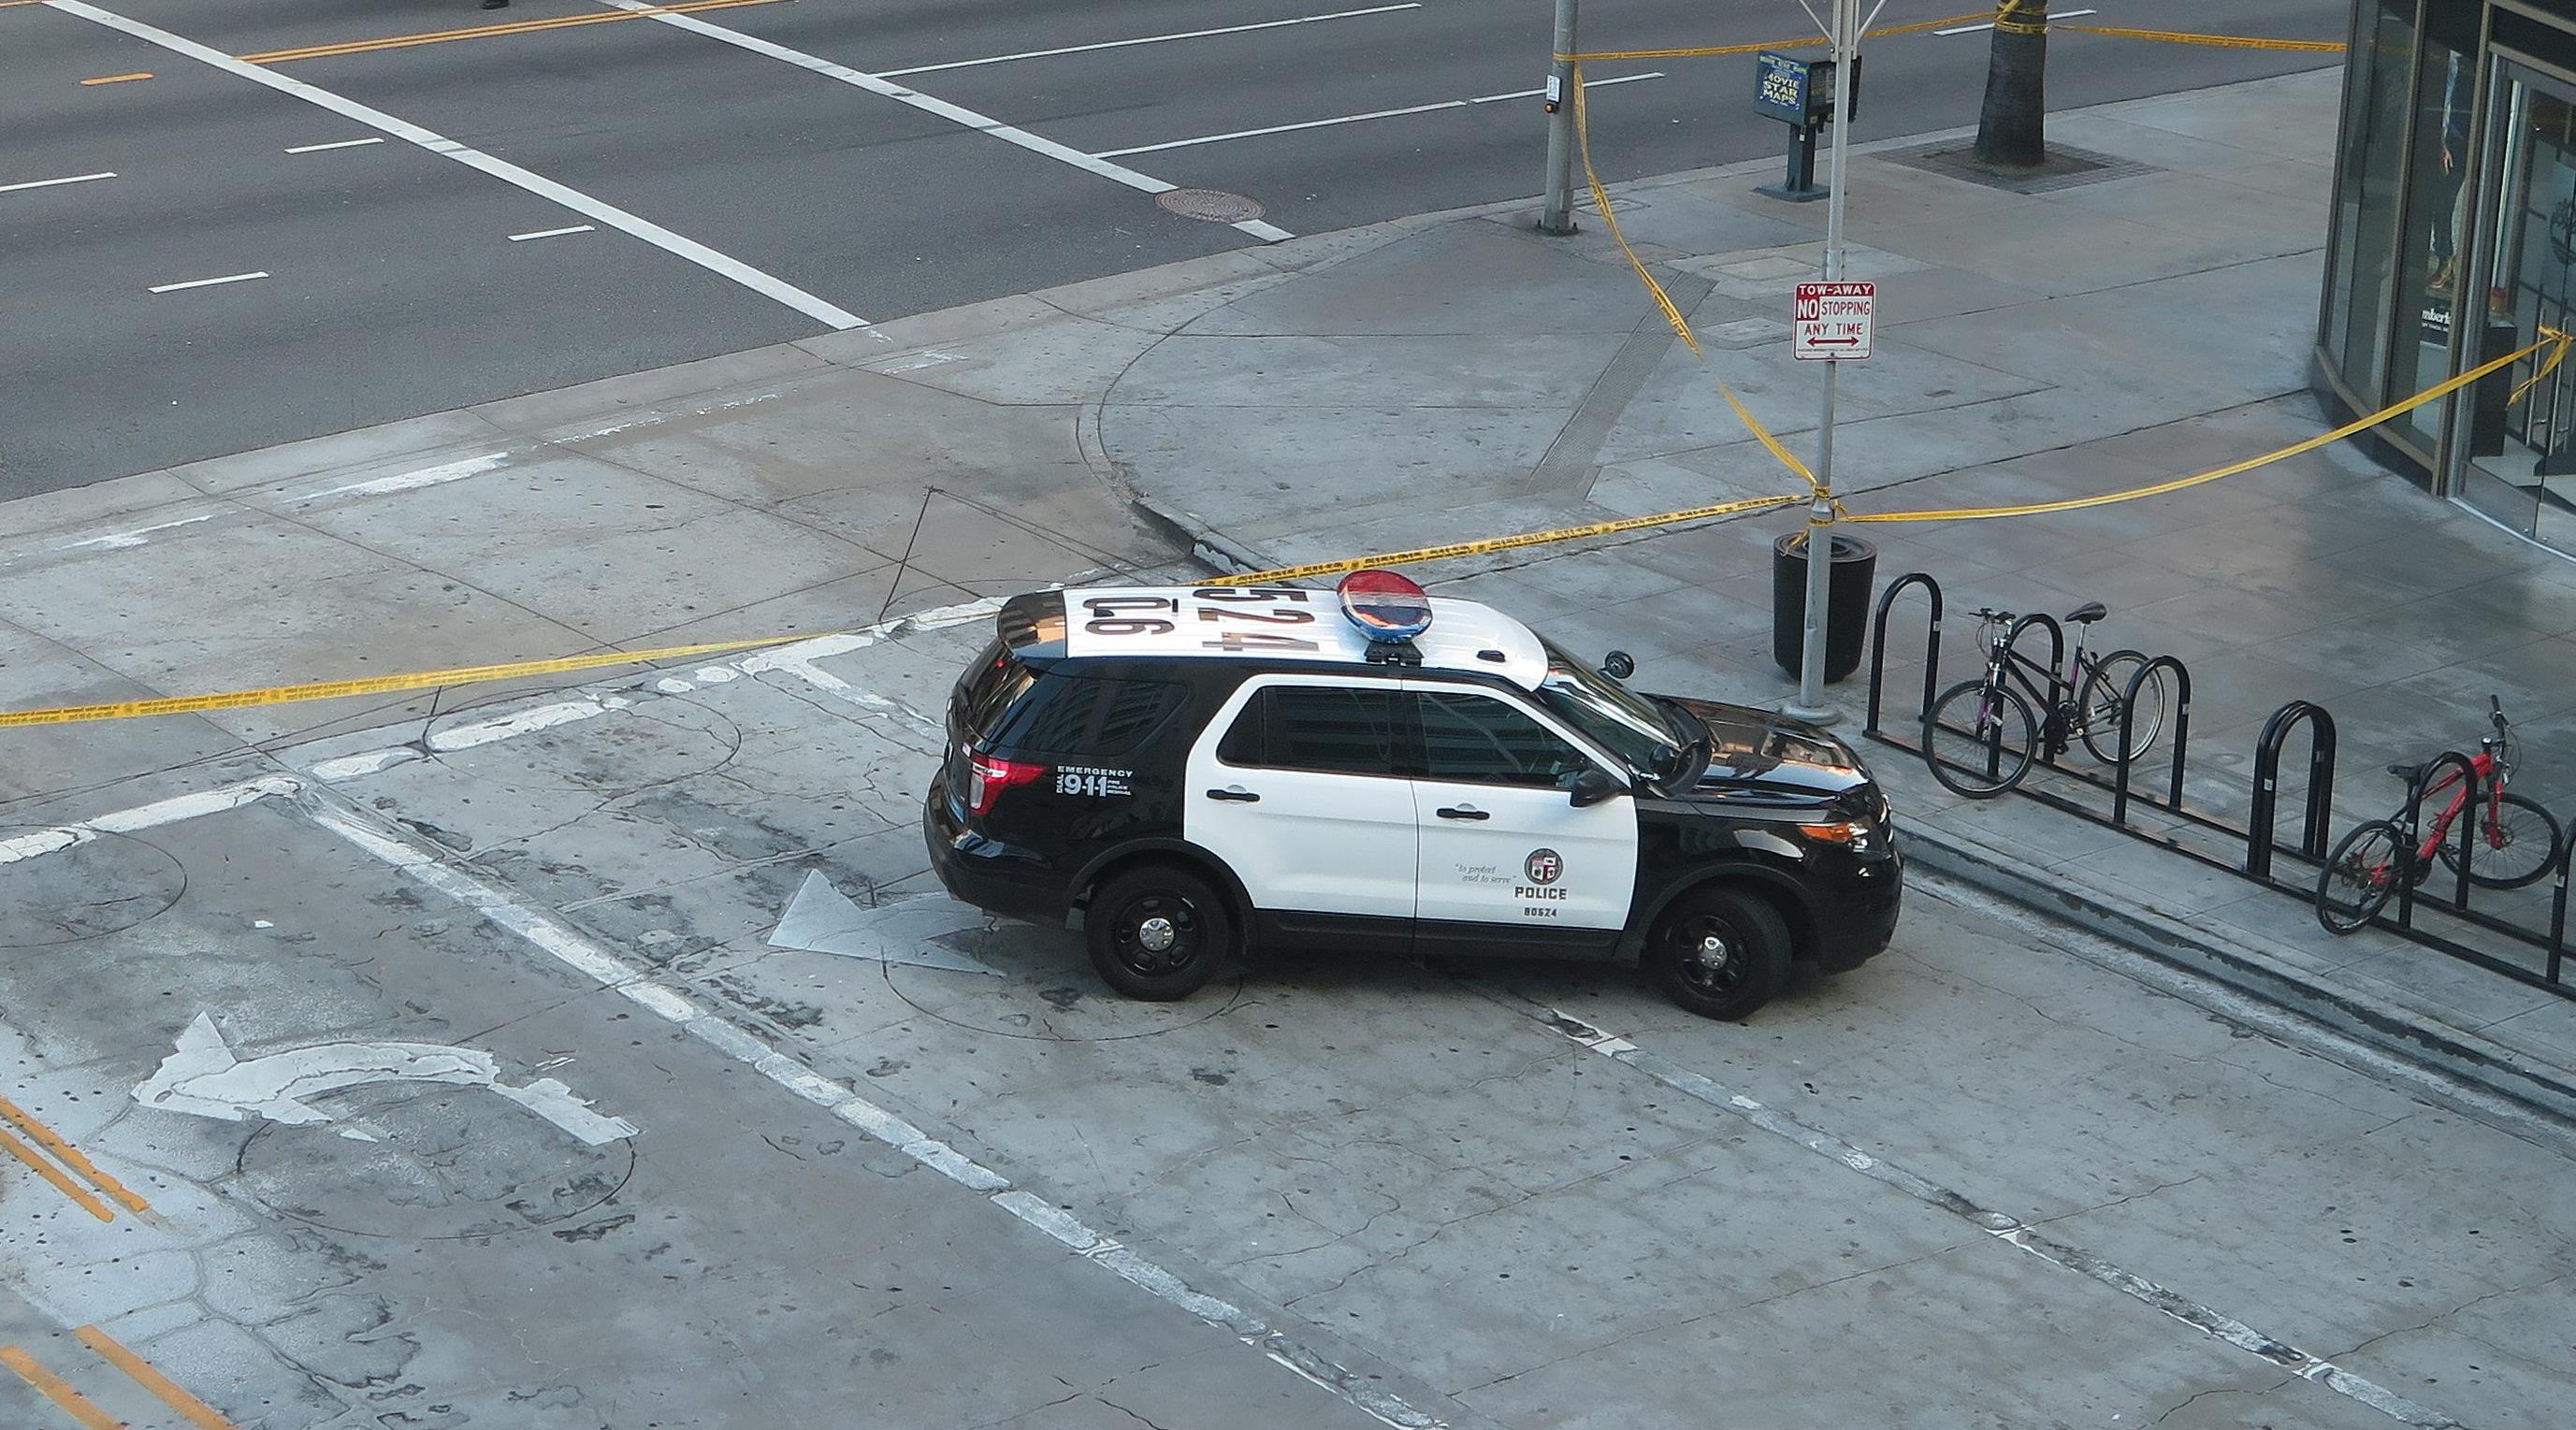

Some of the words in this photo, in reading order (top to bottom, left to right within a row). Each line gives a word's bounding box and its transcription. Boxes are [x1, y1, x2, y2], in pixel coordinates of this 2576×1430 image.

[1763, 80, 1798, 98] STAR
[1763, 89, 1797, 105] MAPS
[1799, 284, 1872, 296] TOW-AWAY
[1797, 299, 1818, 319] NO
[1821, 301, 1871, 316] STOPPING
[2422, 308, 2451, 325] mberl
[1803, 323, 1830, 336] ANY
[1836, 323, 1863, 336] TIME
[1193, 588, 1320, 652] 524
[1057, 765, 1133, 778] EMERGENCY
[1056, 773, 1064, 794] DIAL
[1514, 887, 1567, 900] POLICE
